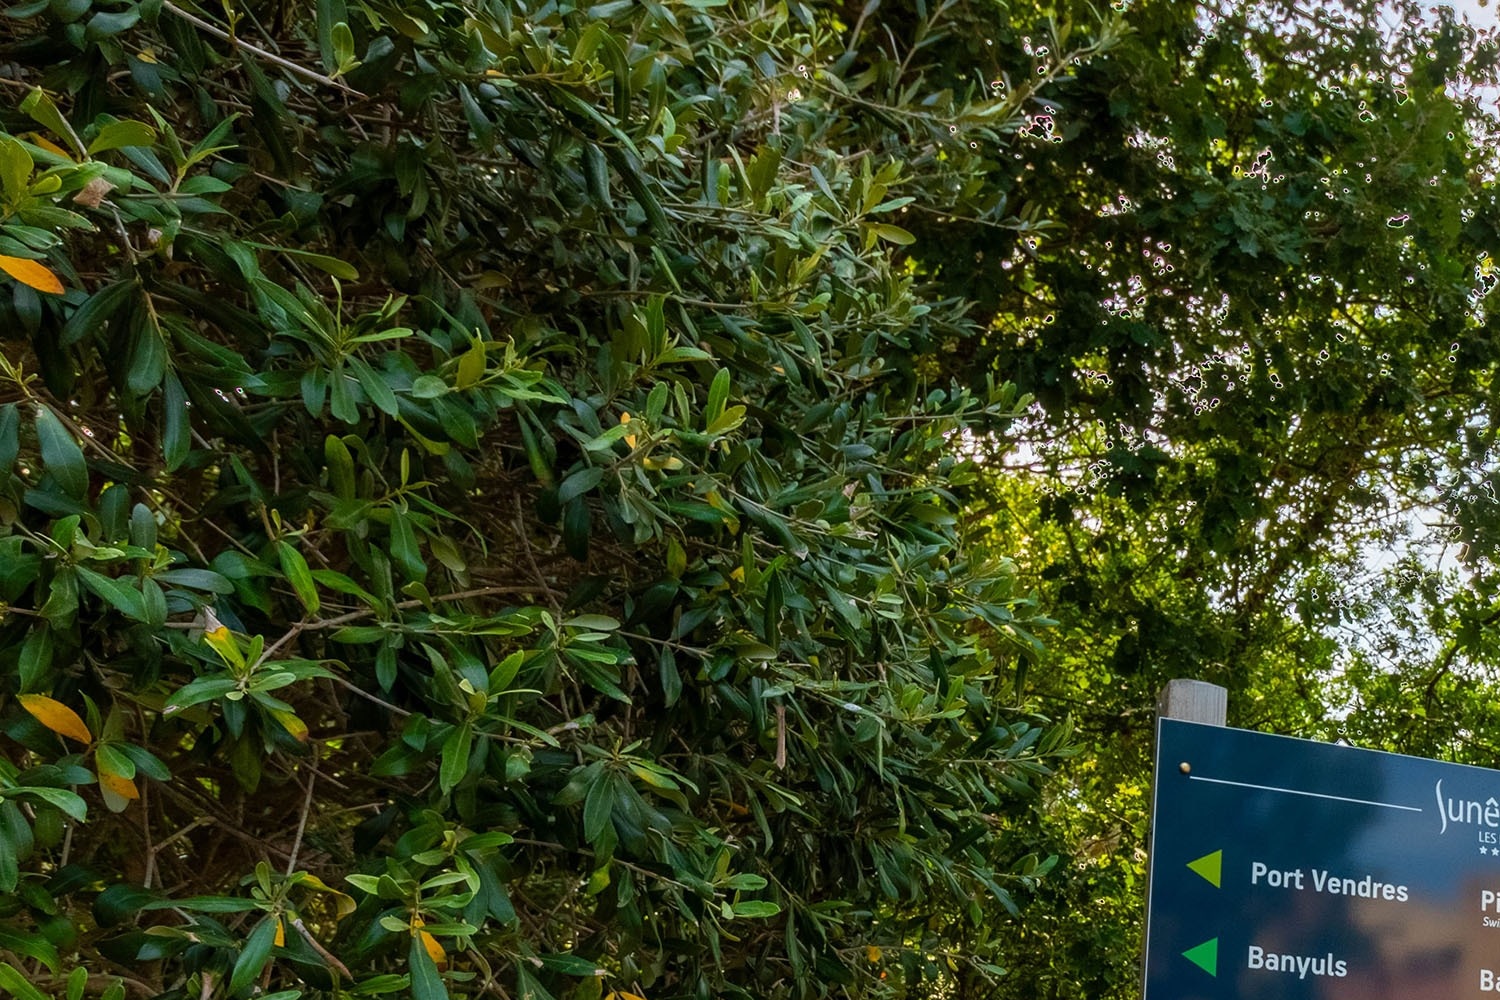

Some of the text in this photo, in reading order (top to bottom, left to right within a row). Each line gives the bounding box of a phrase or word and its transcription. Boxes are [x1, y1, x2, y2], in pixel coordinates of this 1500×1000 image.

[1479, 831, 1497, 844] LES
[1252, 862, 1408, 902] Port Vendres
[1248, 946, 1347, 979] Banyuls
